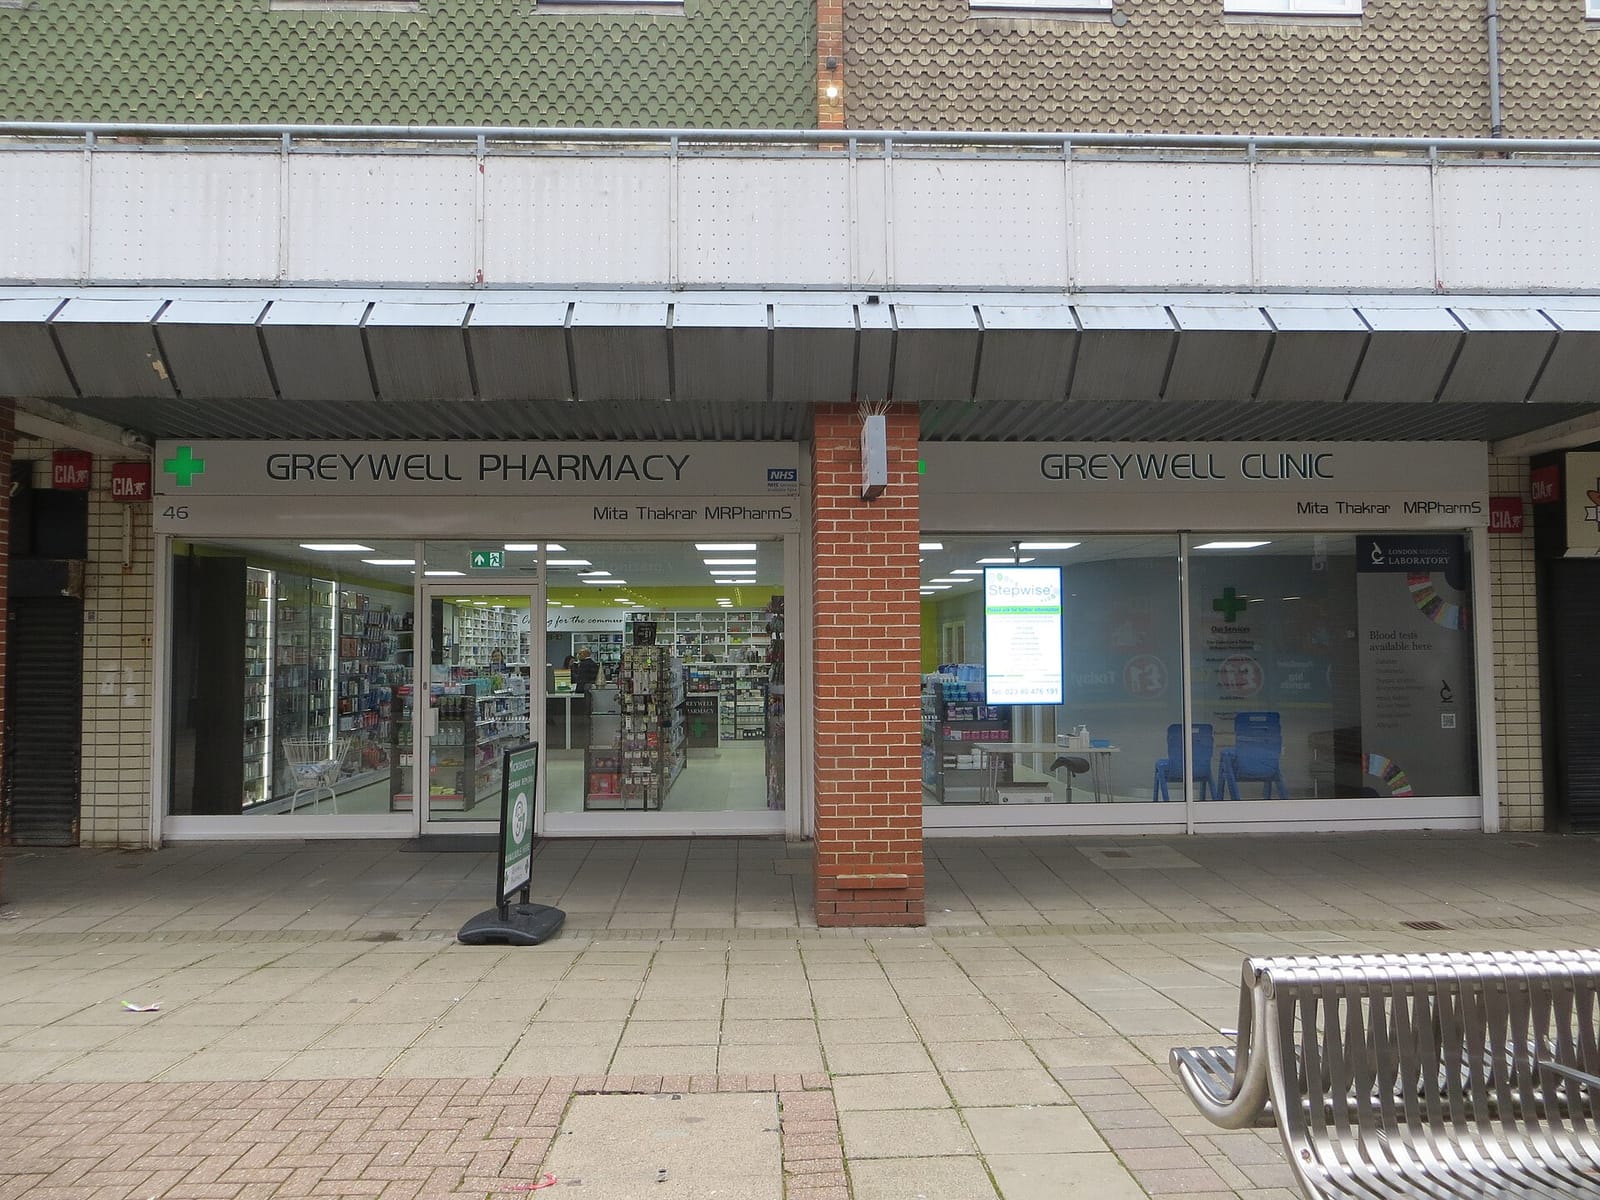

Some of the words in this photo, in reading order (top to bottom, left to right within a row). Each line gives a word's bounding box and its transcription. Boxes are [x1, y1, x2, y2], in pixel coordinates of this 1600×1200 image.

[266, 453, 462, 480] GREYWELL
[479, 453, 690, 480] PHARMACY
[1041, 453, 1226, 480] GREYWELL
[1240, 453, 1334, 479] CLINIC
[55, 464, 76, 484] CIA
[770, 471, 795, 480] NHS
[112, 477, 134, 496] CIA
[1532, 480, 1546, 500] CIA
[162, 505, 189, 520] 46
[593, 506, 628, 520] Mita
[636, 506, 698, 520] Thakrar
[704, 506, 792, 520] MRPharmS
[1297, 502, 1329, 514] Mita
[1335, 502, 1391, 514] Thakrar
[1403, 501, 1482, 514] MRPharmS
[1491, 511, 1512, 529] CIA
[1388, 557, 1450, 565] LABORATORY
[988, 584, 1051, 598] Stepwise
[570, 615, 586, 624] the
[1224, 625, 1251, 634] Services
[1369, 630, 1397, 640] Blood
[1399, 631, 1418, 640] tests
[1369, 641, 1409, 651] available
[1411, 641, 1433, 651] here
